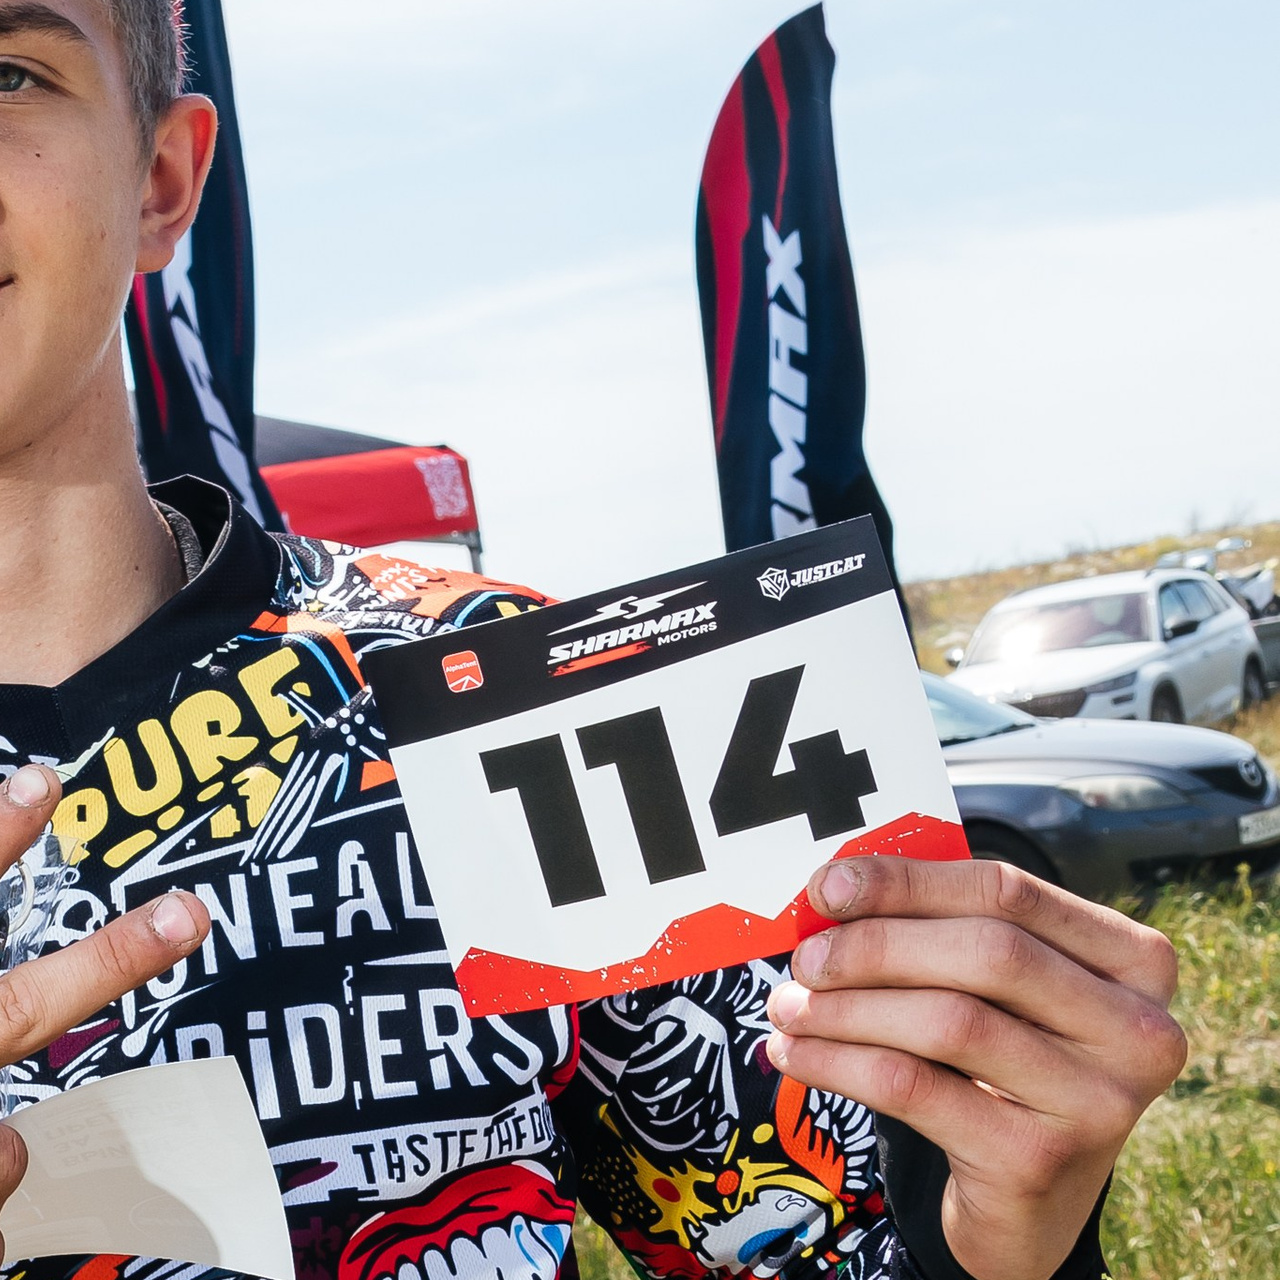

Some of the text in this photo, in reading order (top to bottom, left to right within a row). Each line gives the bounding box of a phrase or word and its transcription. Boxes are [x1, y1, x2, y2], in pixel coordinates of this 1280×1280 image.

[790, 553, 866, 587] JUSTCAT
[547, 601, 718, 666] SHARMAX
[657, 621, 718, 647] MOTORS
[445, 660, 478, 674] AlphaTent
[479, 663, 878, 908] 114
